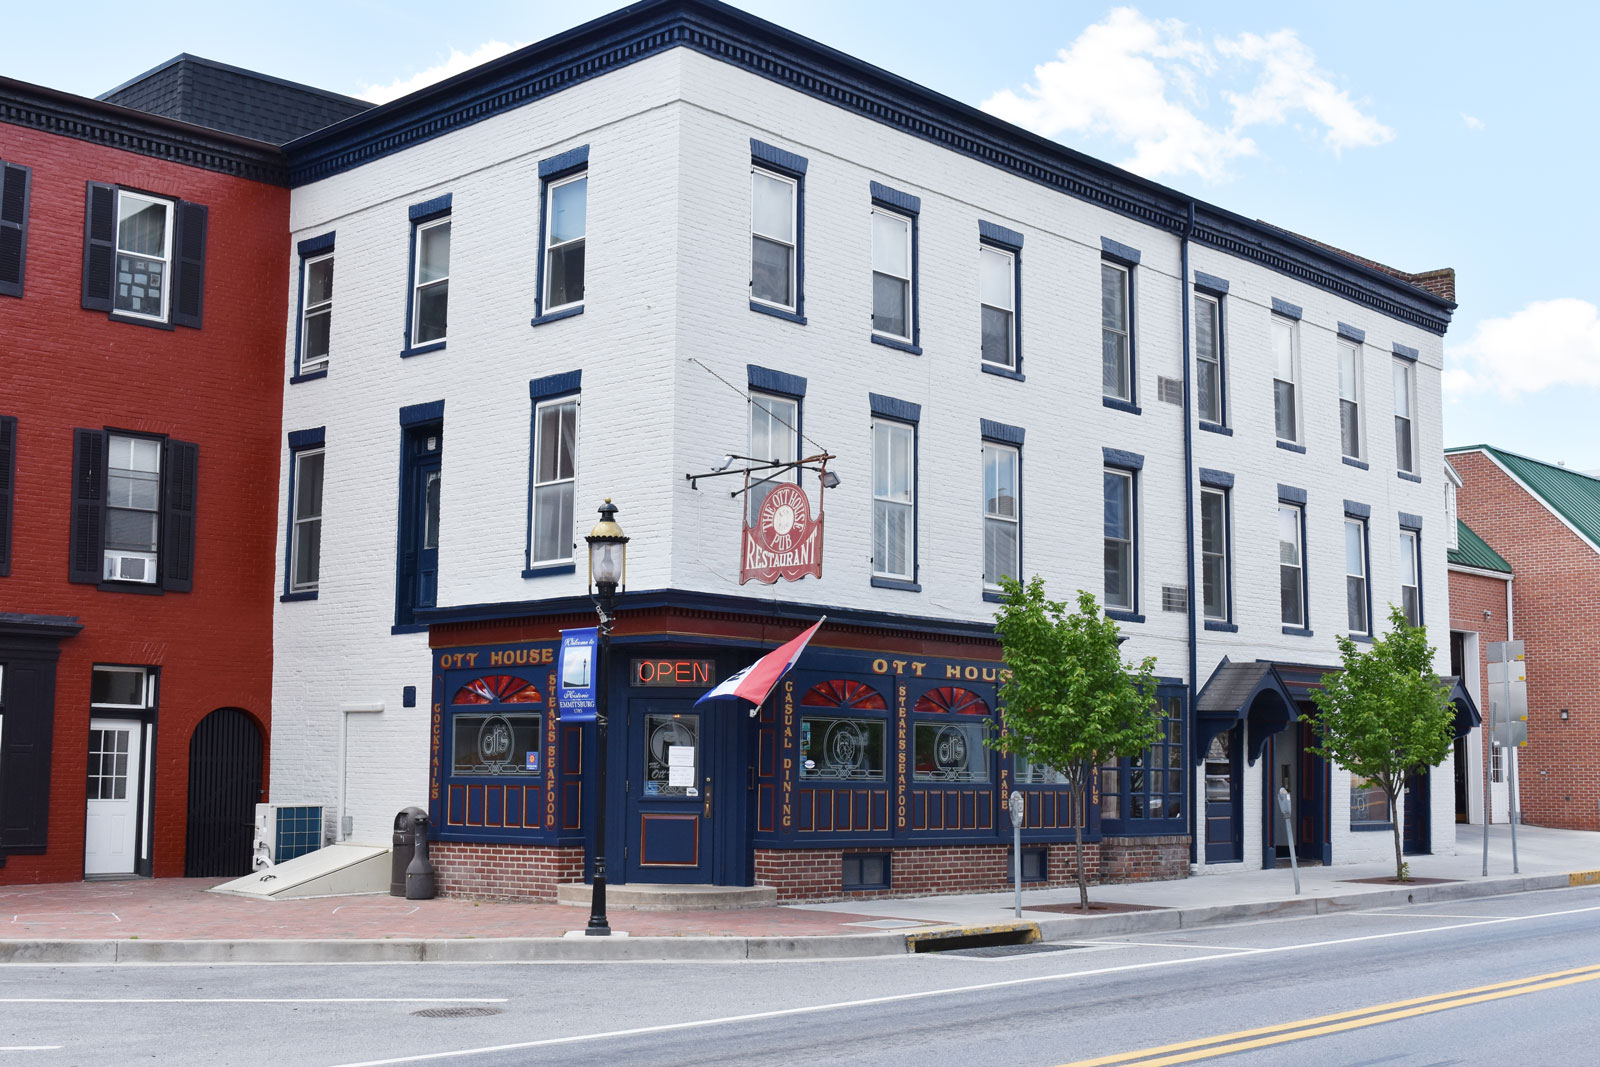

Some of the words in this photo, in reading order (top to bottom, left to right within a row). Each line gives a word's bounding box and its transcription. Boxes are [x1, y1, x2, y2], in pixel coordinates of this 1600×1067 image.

[763, 503, 776, 532] THE
[772, 489, 790, 507] OTT
[789, 491, 805, 532] HOUSE
[770, 533, 792, 550] PUB
[745, 525, 818, 569] RESTAURANT
[441, 652, 479, 669] OTT
[490, 648, 554, 666] HOUSE
[639, 661, 709, 682] OPEN
[872, 659, 927, 677] OTT
[946, 664, 1014, 683] HOUS
[547, 674, 557, 742] STEAKS
[784, 681, 793, 748] CASUAL
[898, 687, 906, 750] STEAKS
[432, 703, 440, 799] COCKTAILS
[547, 746, 556, 825] SEAFOOD
[783, 758, 792, 826] DINING
[898, 753, 906, 827] SEAFOOD
